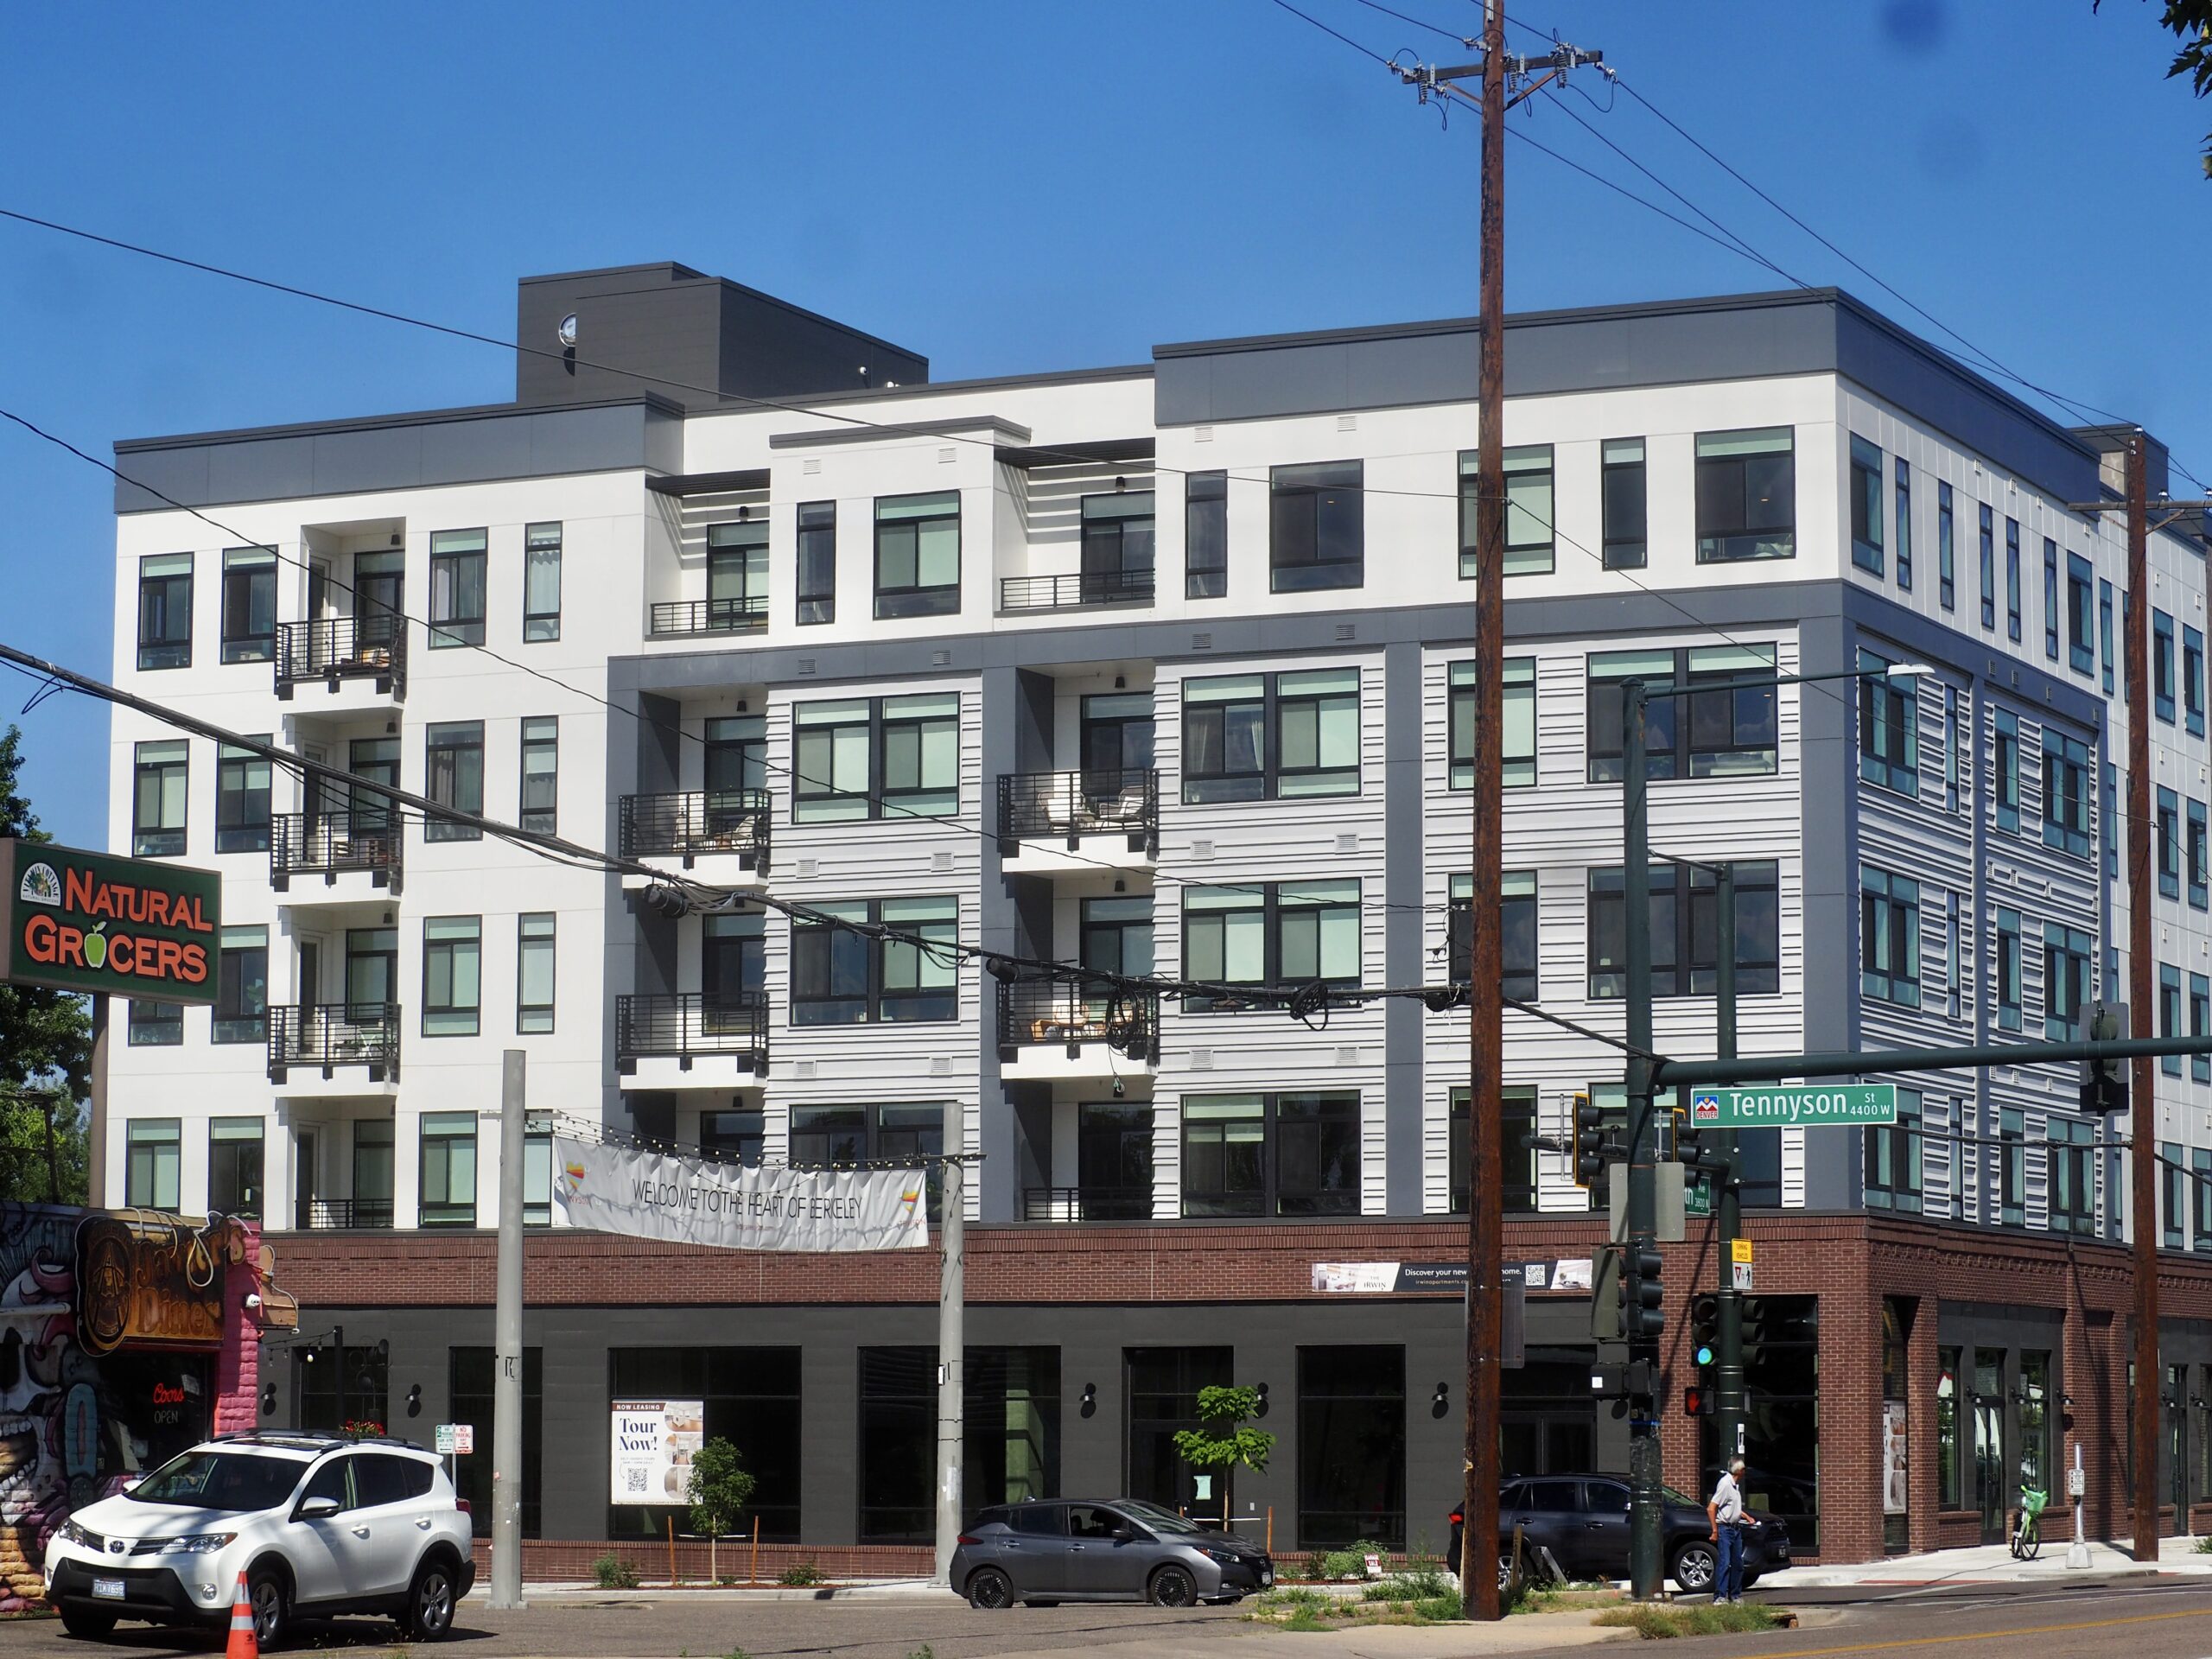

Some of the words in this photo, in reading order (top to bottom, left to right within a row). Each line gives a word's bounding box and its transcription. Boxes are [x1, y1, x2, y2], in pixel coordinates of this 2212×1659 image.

[66, 868, 213, 931] NATURAL
[24, 914, 207, 982] GROCERS
[1729, 1092, 1847, 1122] Tennyson
[1865, 1092, 1875, 1103] St
[1850, 1105, 1878, 1116] 4400
[1880, 1104, 1891, 1115] W
[632, 1178, 698, 1210] WELCOME
[702, 1189, 720, 1212] TO
[721, 1192, 742, 1215] THE
[748, 1192, 784, 1217] HEART
[788, 1197, 806, 1218] OF
[810, 1197, 862, 1219] BERKELEY
[137, 1287, 222, 1336] Diner
[154, 1382, 184, 1403] Coors
[154, 1410, 179, 1424] OPEN
[619, 1418, 657, 1433] Tour
[619, 1436, 658, 1451] Now!
